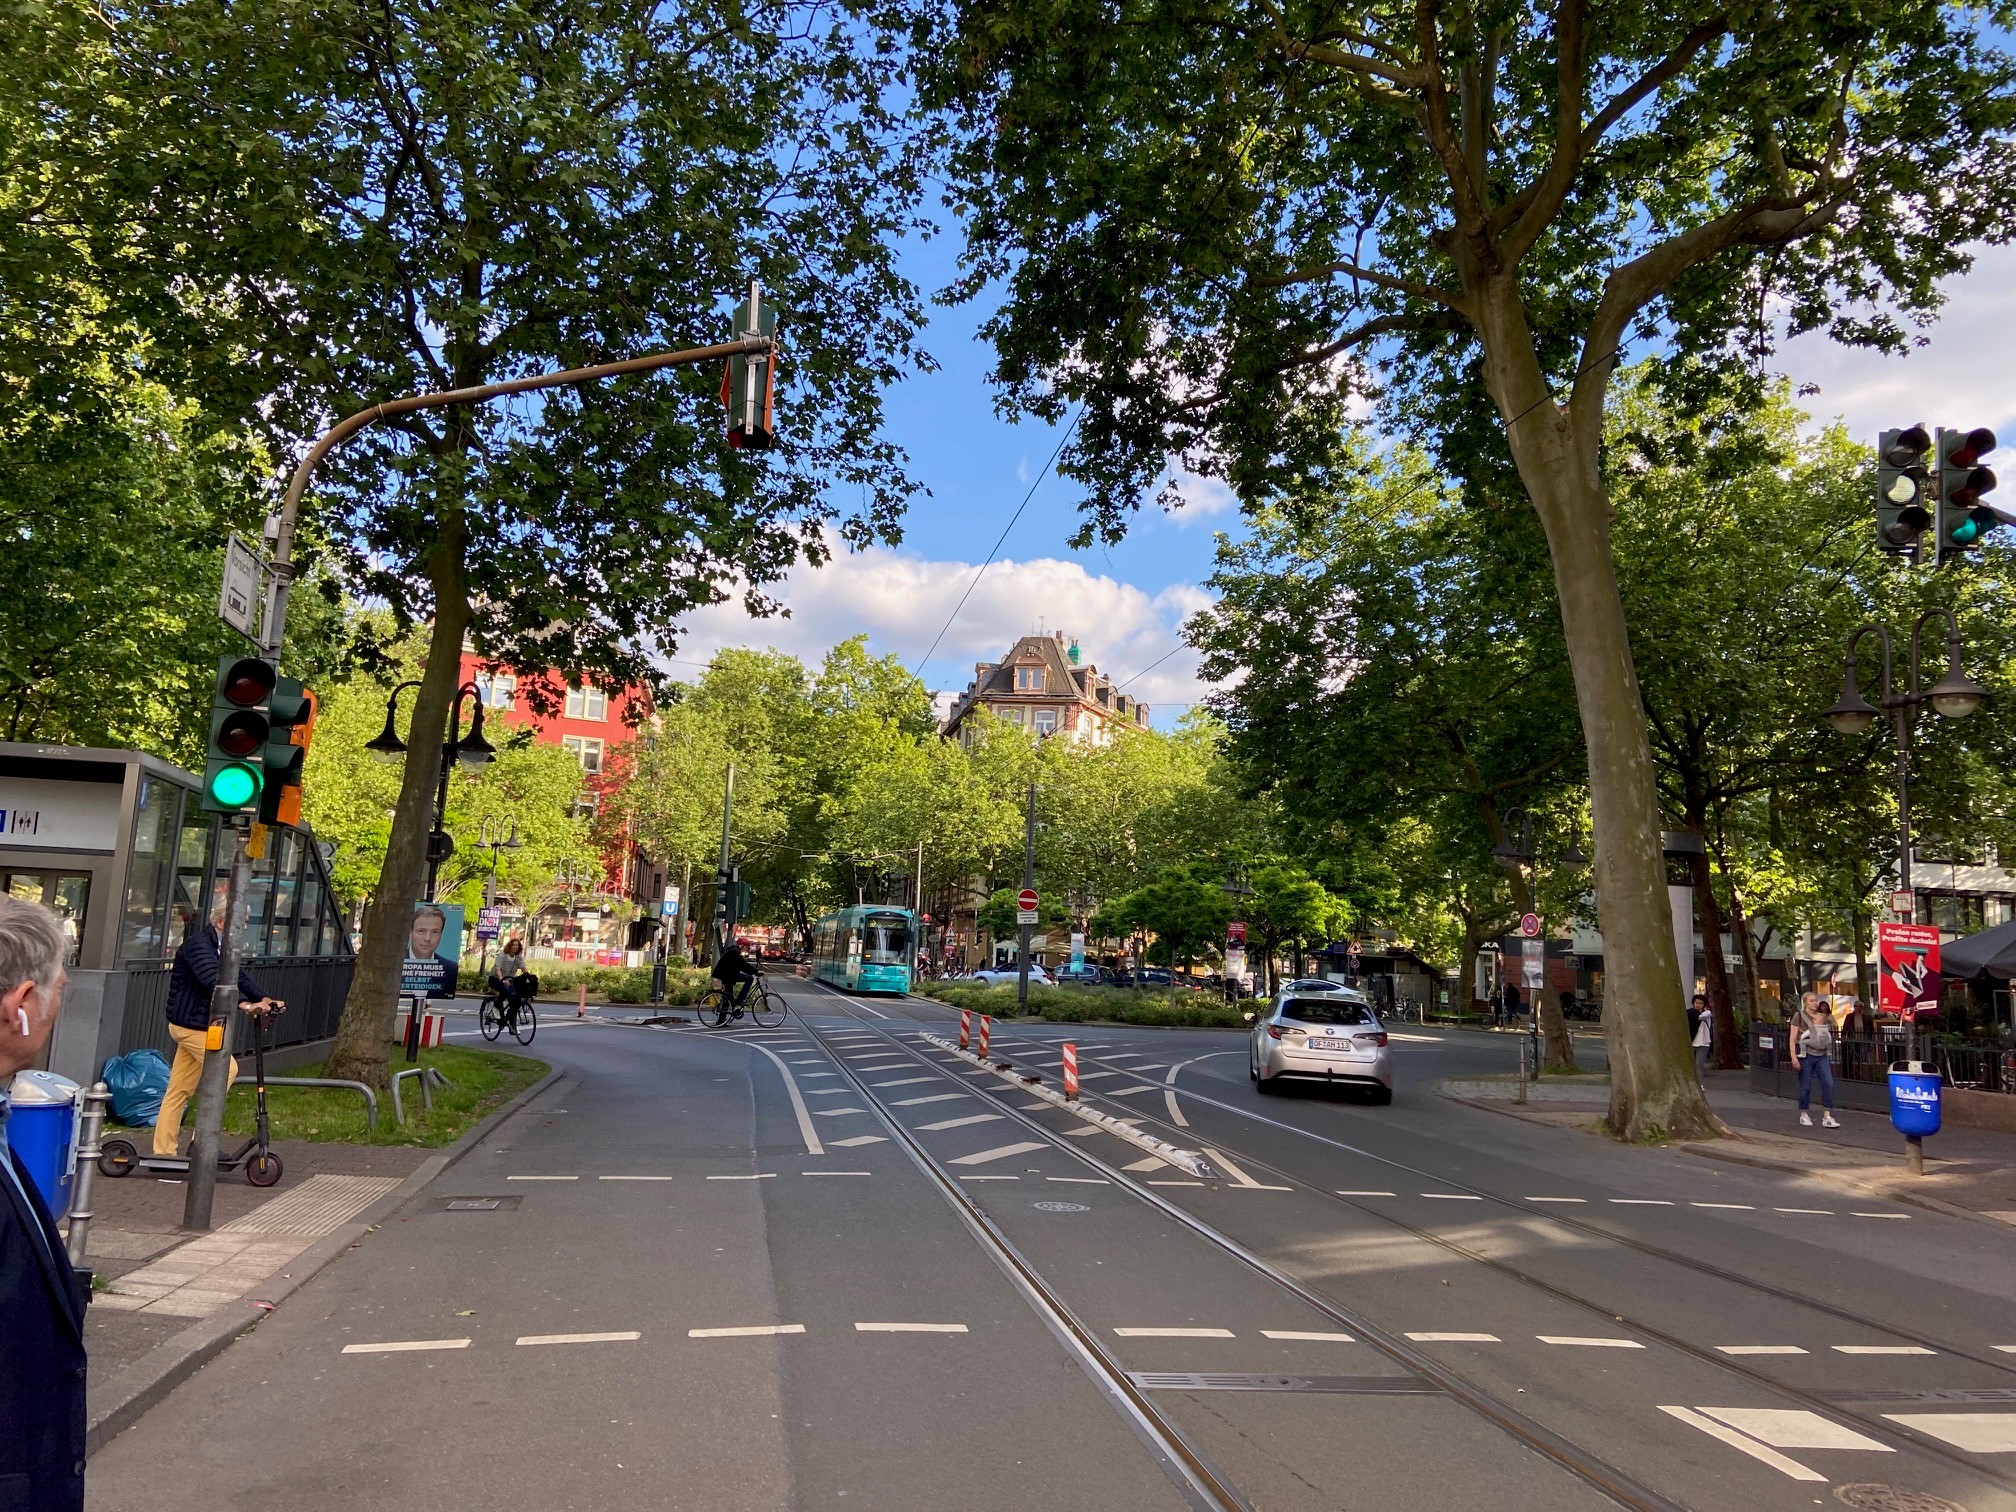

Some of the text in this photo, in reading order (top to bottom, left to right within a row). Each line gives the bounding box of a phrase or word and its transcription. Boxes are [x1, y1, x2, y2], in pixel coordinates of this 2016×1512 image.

[666, 903, 675, 912] U
[480, 910, 500, 918] TRAU
[479, 918, 499, 926] DICH
